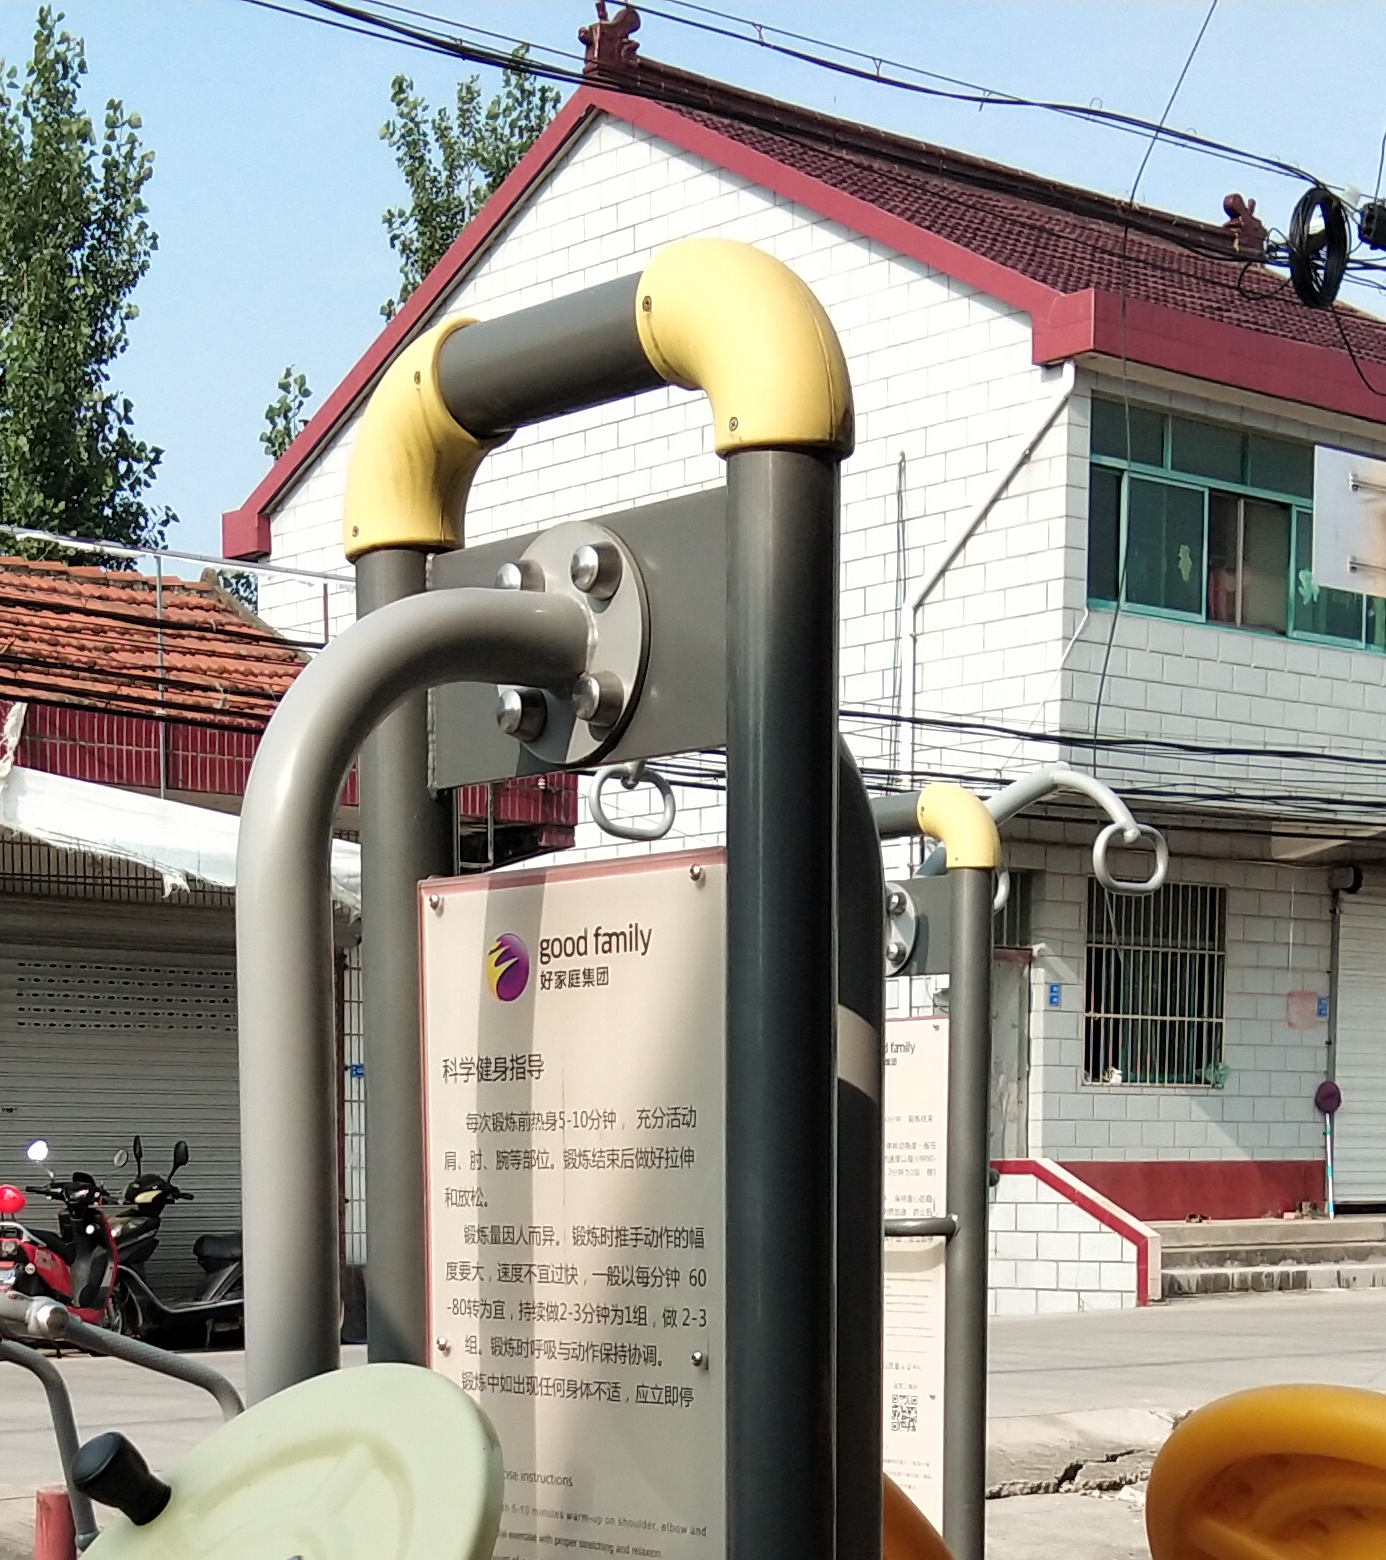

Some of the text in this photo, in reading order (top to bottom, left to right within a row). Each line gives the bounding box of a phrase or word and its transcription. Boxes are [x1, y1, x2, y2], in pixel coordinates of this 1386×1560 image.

[540, 922, 652, 965] good family
[540, 966, 609, 991] 好家庭集团
[442, 1053, 545, 1084] 科学健身指导
[521, 1472, 573, 1487] instructions
[566, 1512, 603, 1525] warm-up
[605, 1516, 616, 1525] on
[661, 1522, 688, 1534] elbow
[690, 1526, 708, 1537] and
[616, 1544, 630, 1555] and
